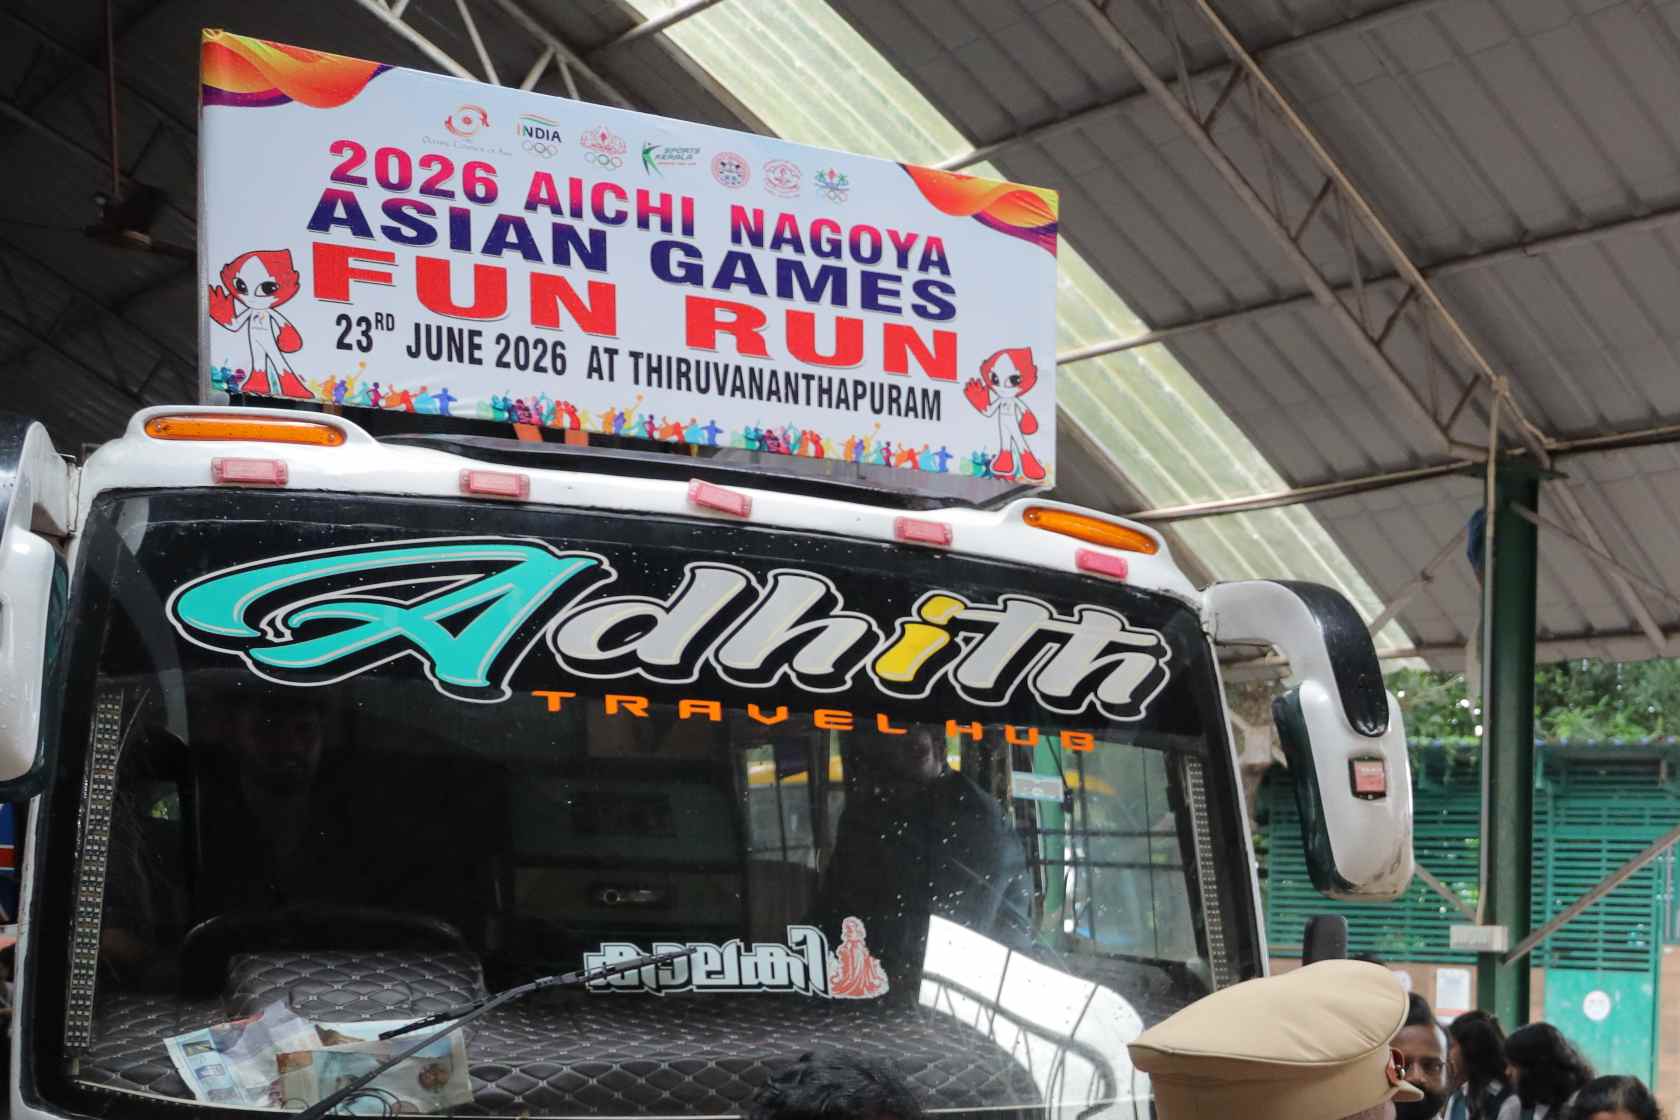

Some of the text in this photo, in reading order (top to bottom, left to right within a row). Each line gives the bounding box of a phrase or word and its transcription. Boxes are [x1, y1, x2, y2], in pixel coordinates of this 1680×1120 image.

[516, 123, 562, 144] INDIA
[307, 188, 957, 322] ASIAN GAMES
[329, 139, 951, 276] 2026 AICHI NAGOYA
[313, 242, 959, 382] FUN RUN
[406, 322, 484, 366] JUNE
[495, 333, 567, 376] 2026
[587, 345, 619, 381] AT
[628, 350, 942, 422] THIRUVANANTHAPURAM
[531, 690, 1097, 752] TRAVEL HUB
